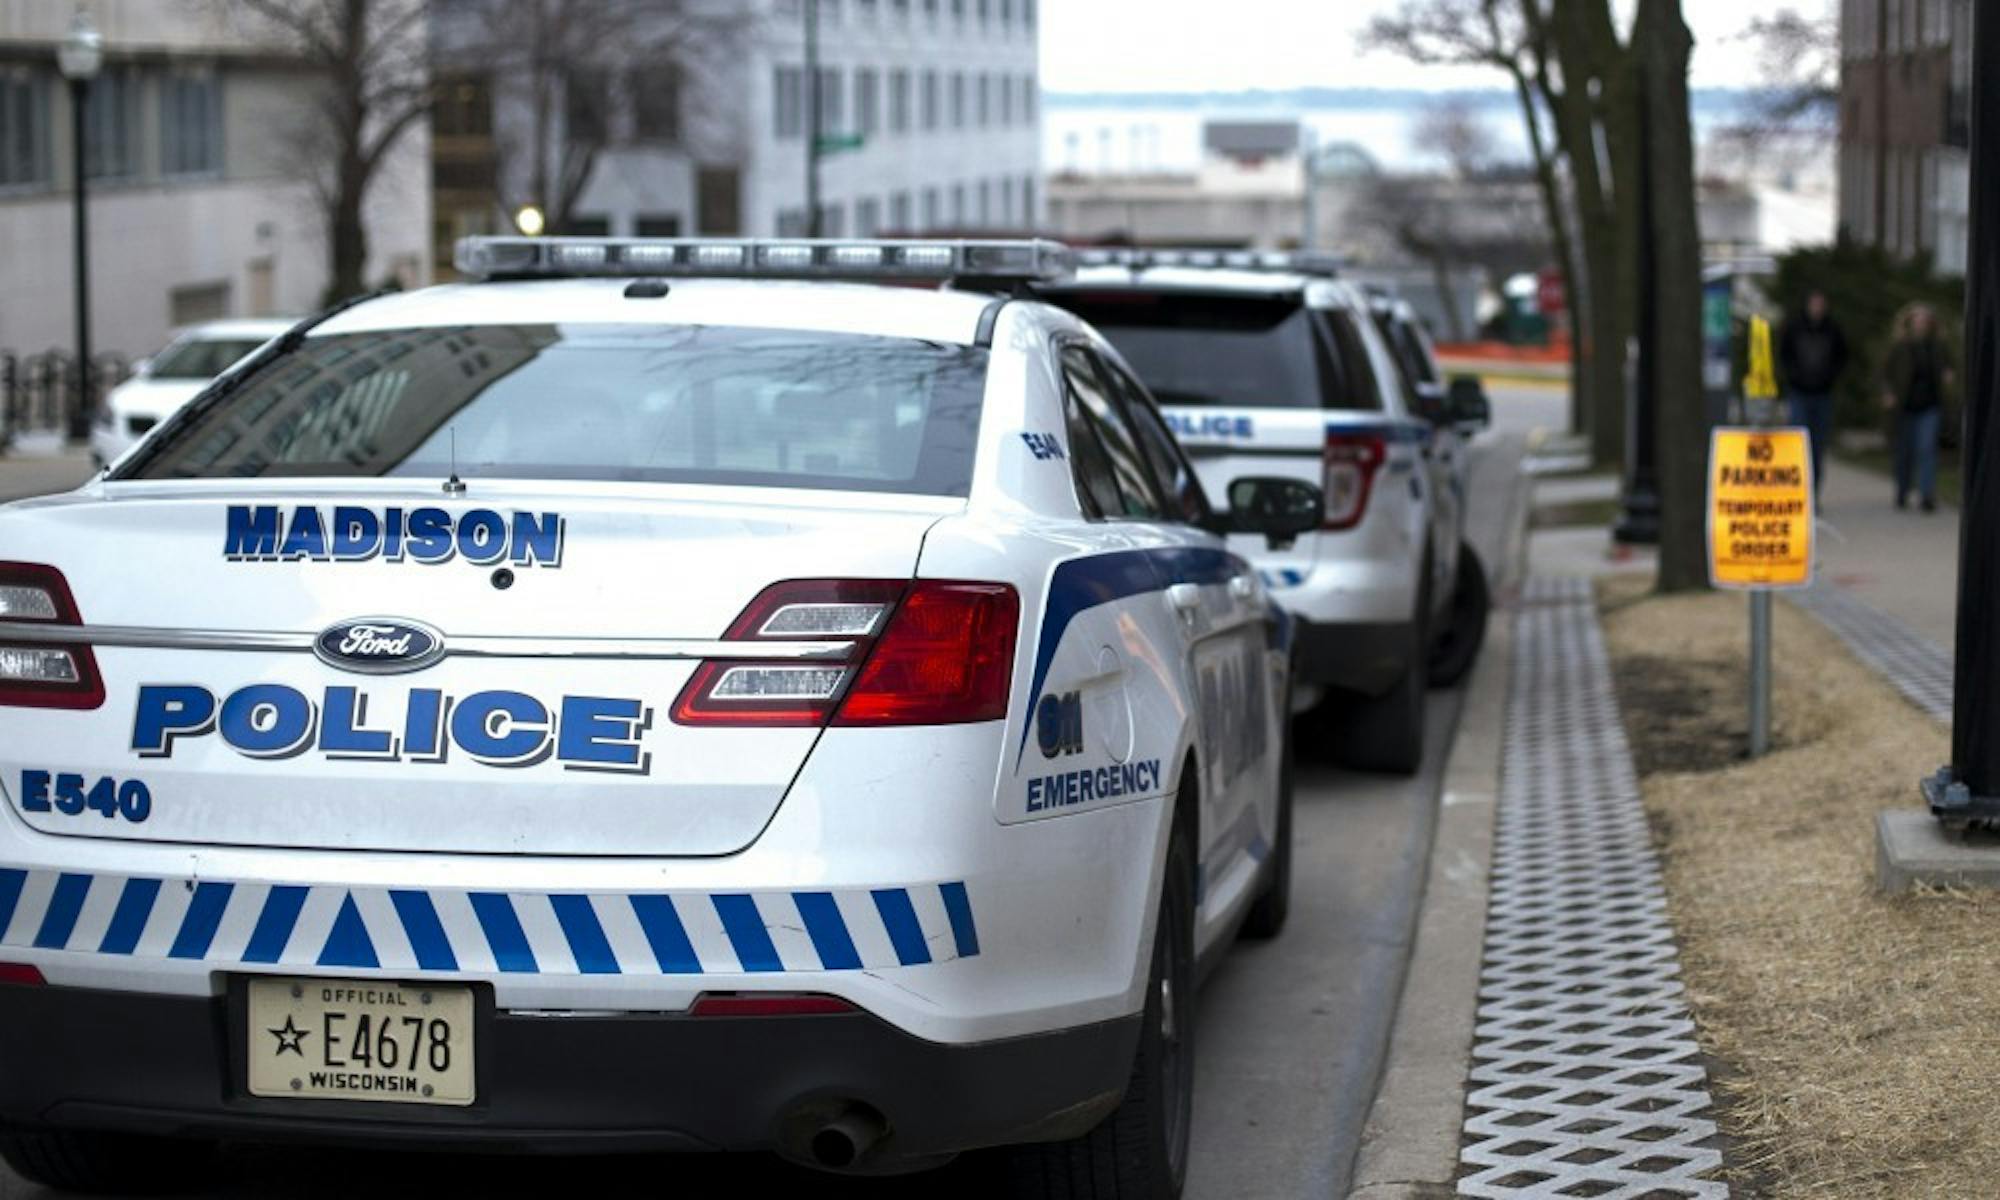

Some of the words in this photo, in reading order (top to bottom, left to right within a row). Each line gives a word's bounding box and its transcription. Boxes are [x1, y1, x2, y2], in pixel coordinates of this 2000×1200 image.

[1164, 414, 1253, 437] OLICE
[1747, 437, 1773, 461] NO
[1720, 466, 1801, 484] PARKING
[1719, 501, 1803, 515] TEMPORARY
[223, 505, 564, 568] MADISON
[1730, 521, 1791, 536] POLICE
[1731, 541, 1790, 557] ORDER
[339, 625, 411, 655] Ford
[131, 684, 651, 774] POLICE
[21, 770, 150, 821] E540
[1026, 760, 1160, 812] EMERGENCY
[322, 989, 406, 1005] OFFICIAL
[324, 1012, 450, 1072] E4678
[309, 1072, 417, 1092] WISCONSIN
